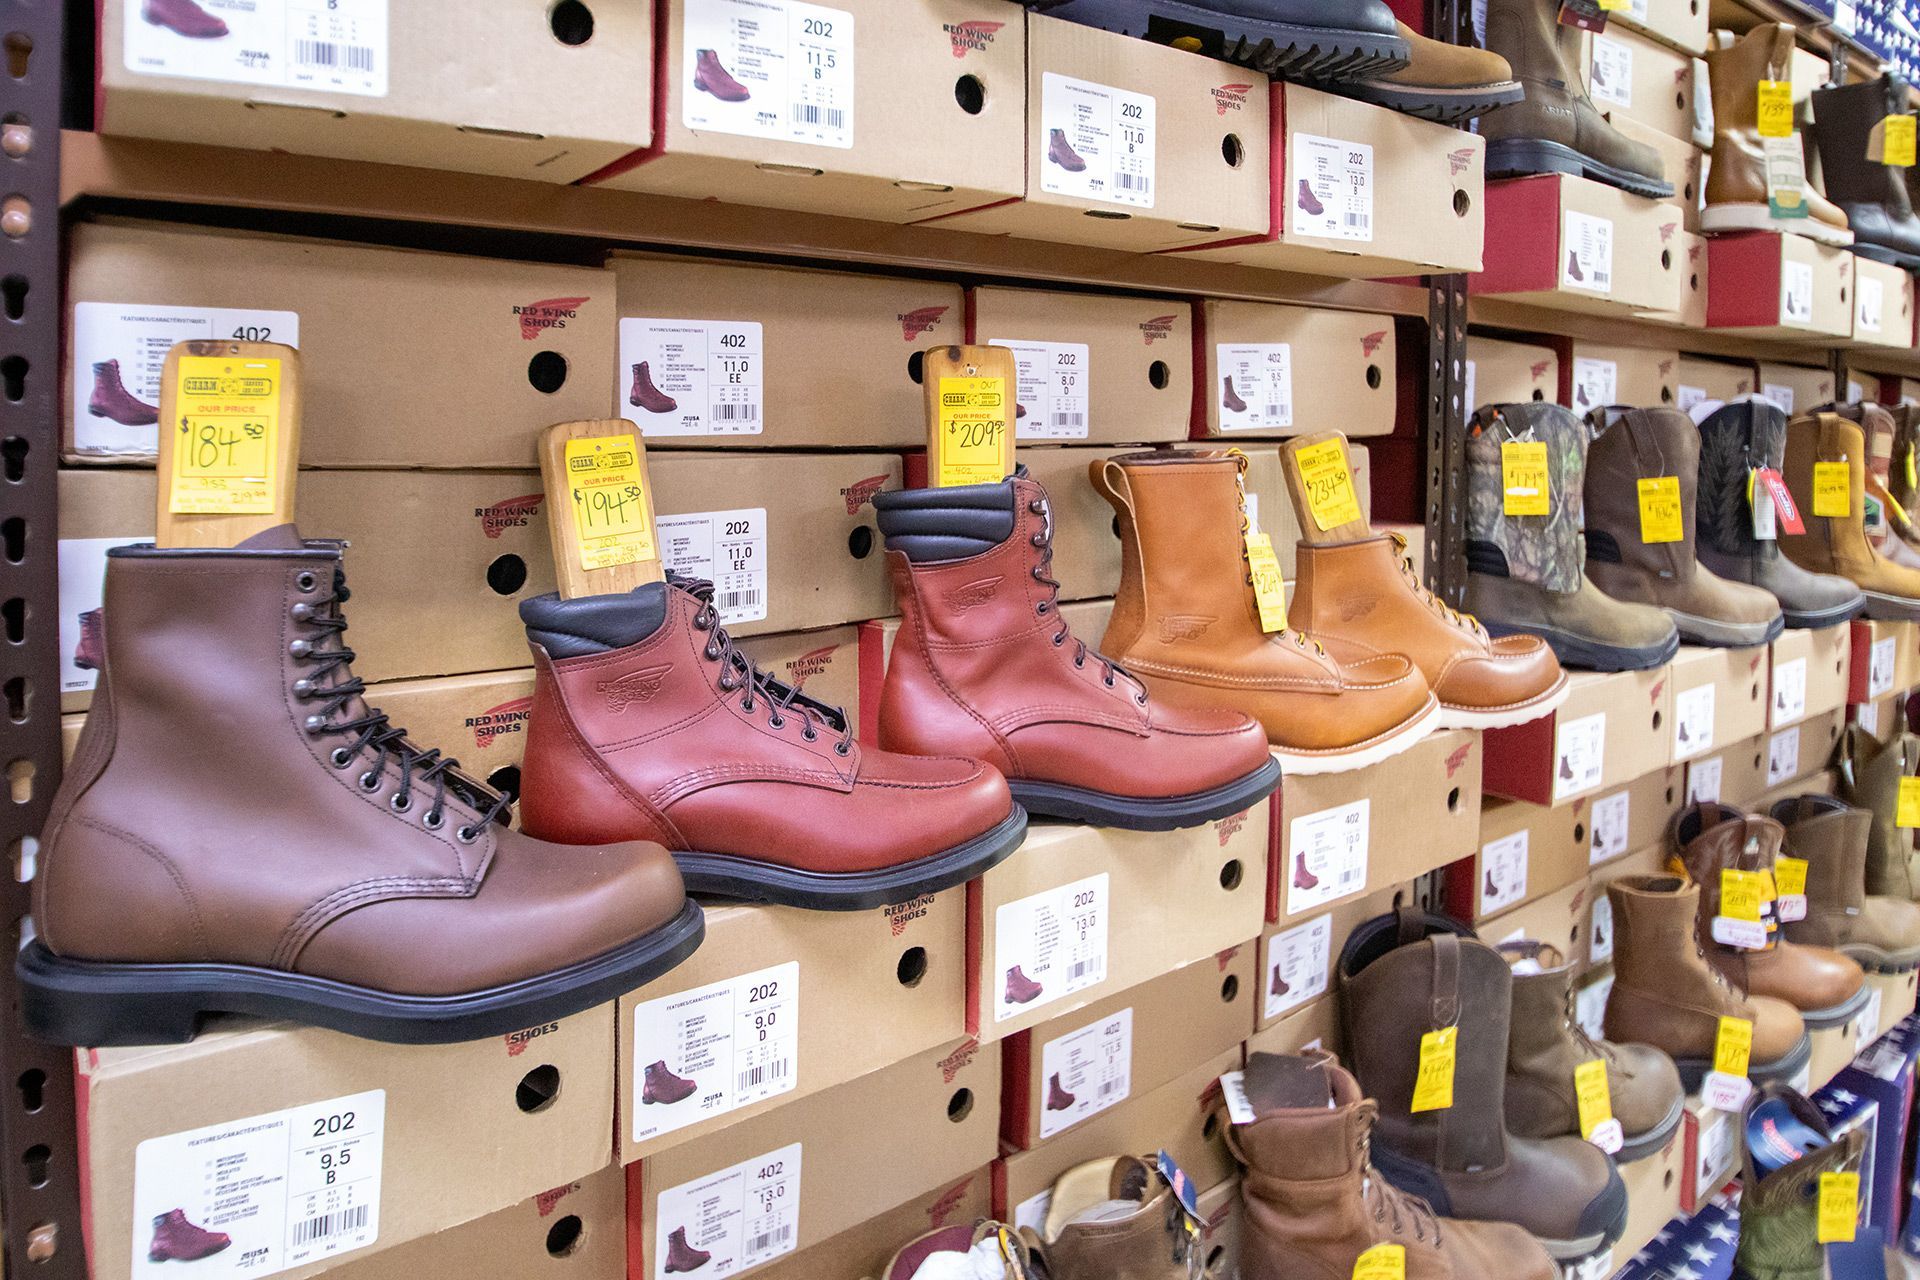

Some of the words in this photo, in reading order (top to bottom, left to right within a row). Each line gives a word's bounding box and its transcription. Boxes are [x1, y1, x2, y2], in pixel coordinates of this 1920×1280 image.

[804, 18, 833, 38] 202
[943, 24, 964, 36] RED
[965, 27, 995, 43] WING
[952, 37, 987, 52] SHOES
[807, 51, 836, 69] 11.5
[814, 68, 822, 80] B
[1211, 88, 1225, 99] RED
[1226, 91, 1247, 104] WING
[1122, 103, 1143, 120] 202
[1217, 98, 1241, 111] SHOES
[1124, 129, 1144, 145] 11.0
[1348, 152, 1364, 166] 202
[1350, 175, 1365, 187] 13.0
[512, 304, 539, 316] RED
[542, 306, 577, 320] WING
[523, 316, 567, 329] SHOES
[231, 326, 272, 343] 402
[720, 334, 746, 348] 402
[723, 360, 749, 373] 11.0
[1057, 353, 1076, 366] 202
[728, 373, 742, 384] EE
[1061, 375, 1075, 387] 8.0
[583, 478, 601, 486] OUR
[602, 475, 626, 483] PRICE
[474, 507, 501, 518] RED
[502, 506, 539, 516] WING
[486, 517, 529, 528] SHOES
[725, 520, 750, 536] 202
[728, 546, 752, 560] 11.0
[733, 559, 746, 571] EE
[785, 659, 805, 670] RED
[806, 656, 833, 667] WING
[794, 666, 826, 678] SHOES
[465, 716, 493, 728] RED
[495, 710, 531, 724] WING
[476, 722, 522, 738] SHOES
[884, 904, 905, 917] RED
[907, 894, 935, 911] WING
[1074, 890, 1095, 908] 202
[893, 907, 928, 926] SHOES
[1076, 914, 1097, 932] 13.0
[749, 981, 779, 1003] 202
[755, 1012, 776, 1029] 9.0
[510, 1021, 560, 1045] SHOES
[760, 1029, 767, 1042] D
[312, 1111, 356, 1137] 202
[320, 1148, 352, 1170] 9.5
[326, 1170, 337, 1185] B
[757, 1160, 784, 1181] 402
[760, 1185, 785, 1204] 13.0
